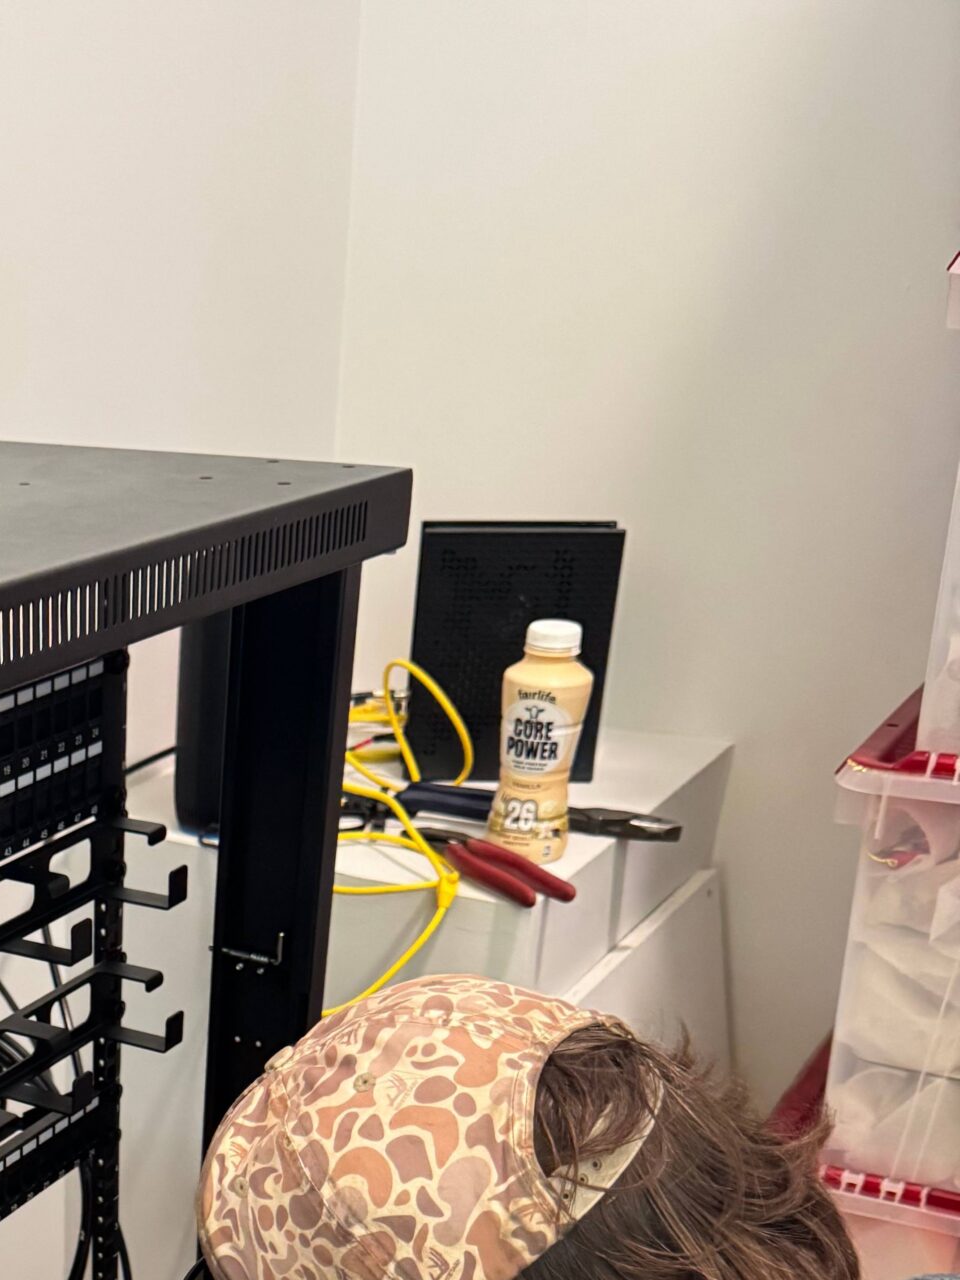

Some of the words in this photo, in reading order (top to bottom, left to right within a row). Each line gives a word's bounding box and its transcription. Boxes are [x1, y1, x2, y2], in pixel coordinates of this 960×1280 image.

[513, 717, 554, 741] CORE
[3, 766, 11, 775] 19
[22, 758, 30, 768] 20
[40, 750, 48, 760] 21
[58, 742, 66, 752] 22
[75, 735, 82, 745] 23
[92, 728, 100, 738] 24
[505, 736, 558, 761] POWER
[4, 846, 12, 856] 43
[22, 838, 30, 848] 44
[40, 829, 48, 839] 45
[57, 821, 65, 831] 46
